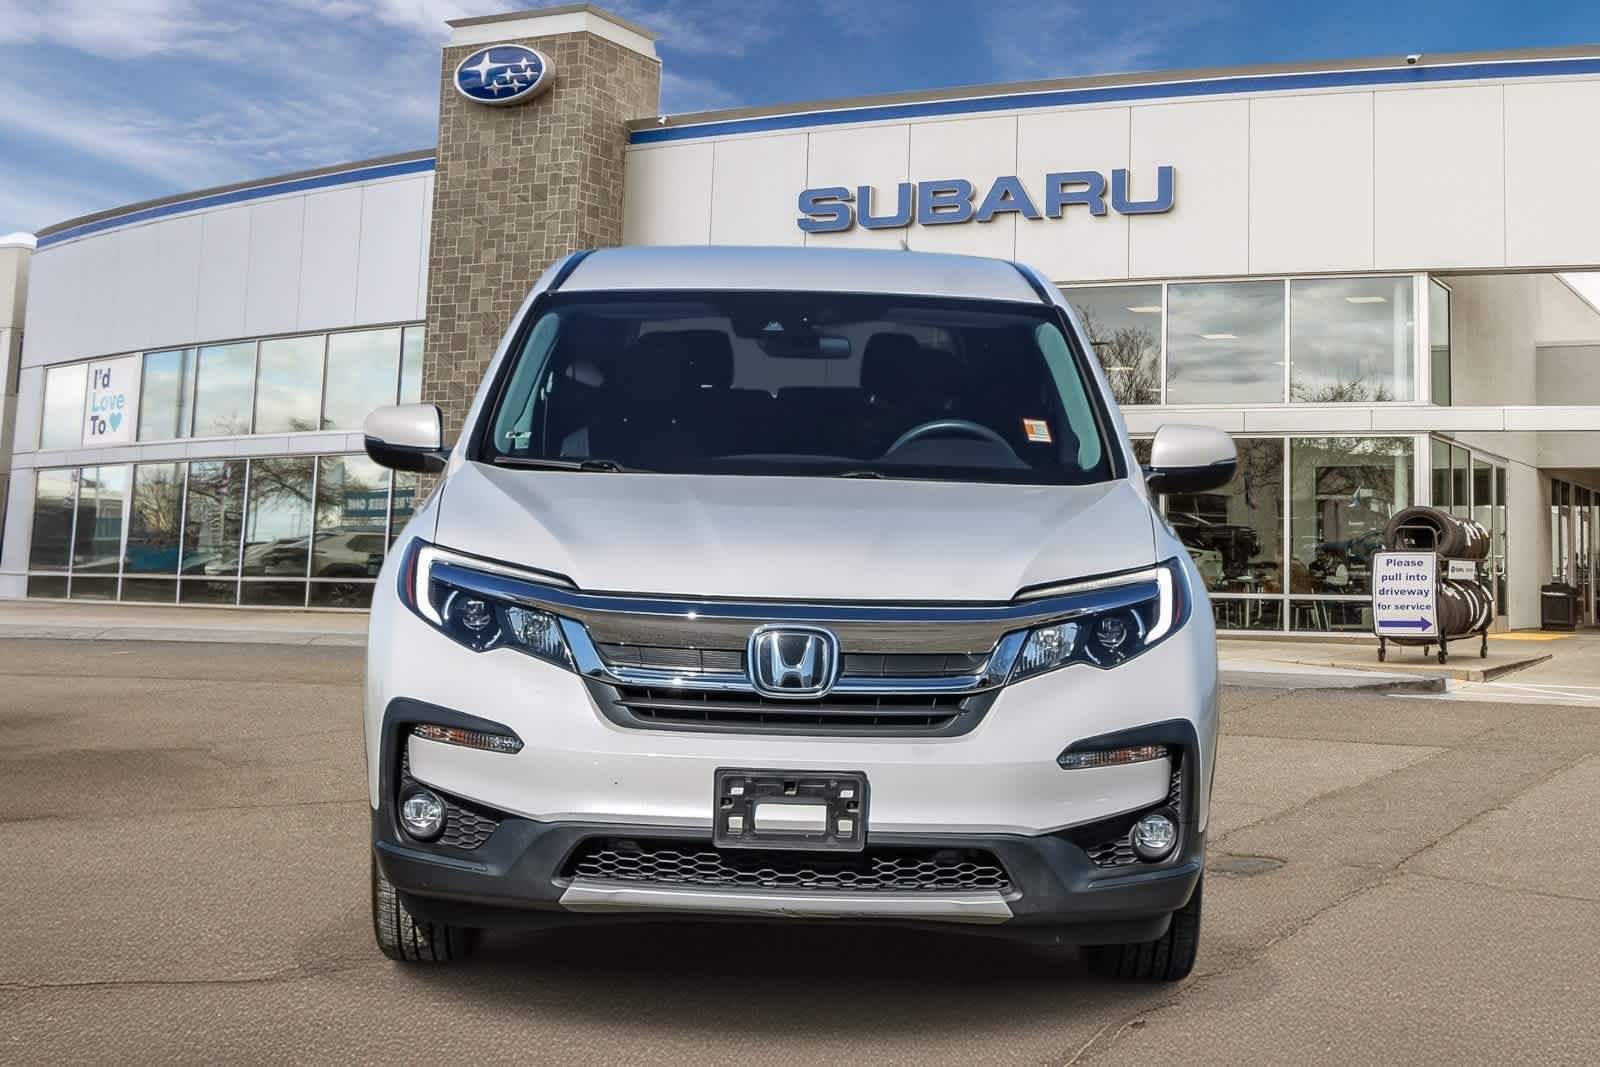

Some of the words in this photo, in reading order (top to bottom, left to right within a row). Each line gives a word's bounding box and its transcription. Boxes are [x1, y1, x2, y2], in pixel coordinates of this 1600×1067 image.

[796, 165, 1176, 233] SUBARU
[93, 367, 111, 389] I'd
[91, 392, 125, 412] Love
[90, 415, 106, 436] To
[1386, 558, 1424, 567] Please
[1381, 573, 1402, 583] pull
[1406, 573, 1428, 581] into
[1378, 587, 1430, 597] driveway
[1377, 602, 1391, 610] for
[1394, 602, 1432, 610] service
